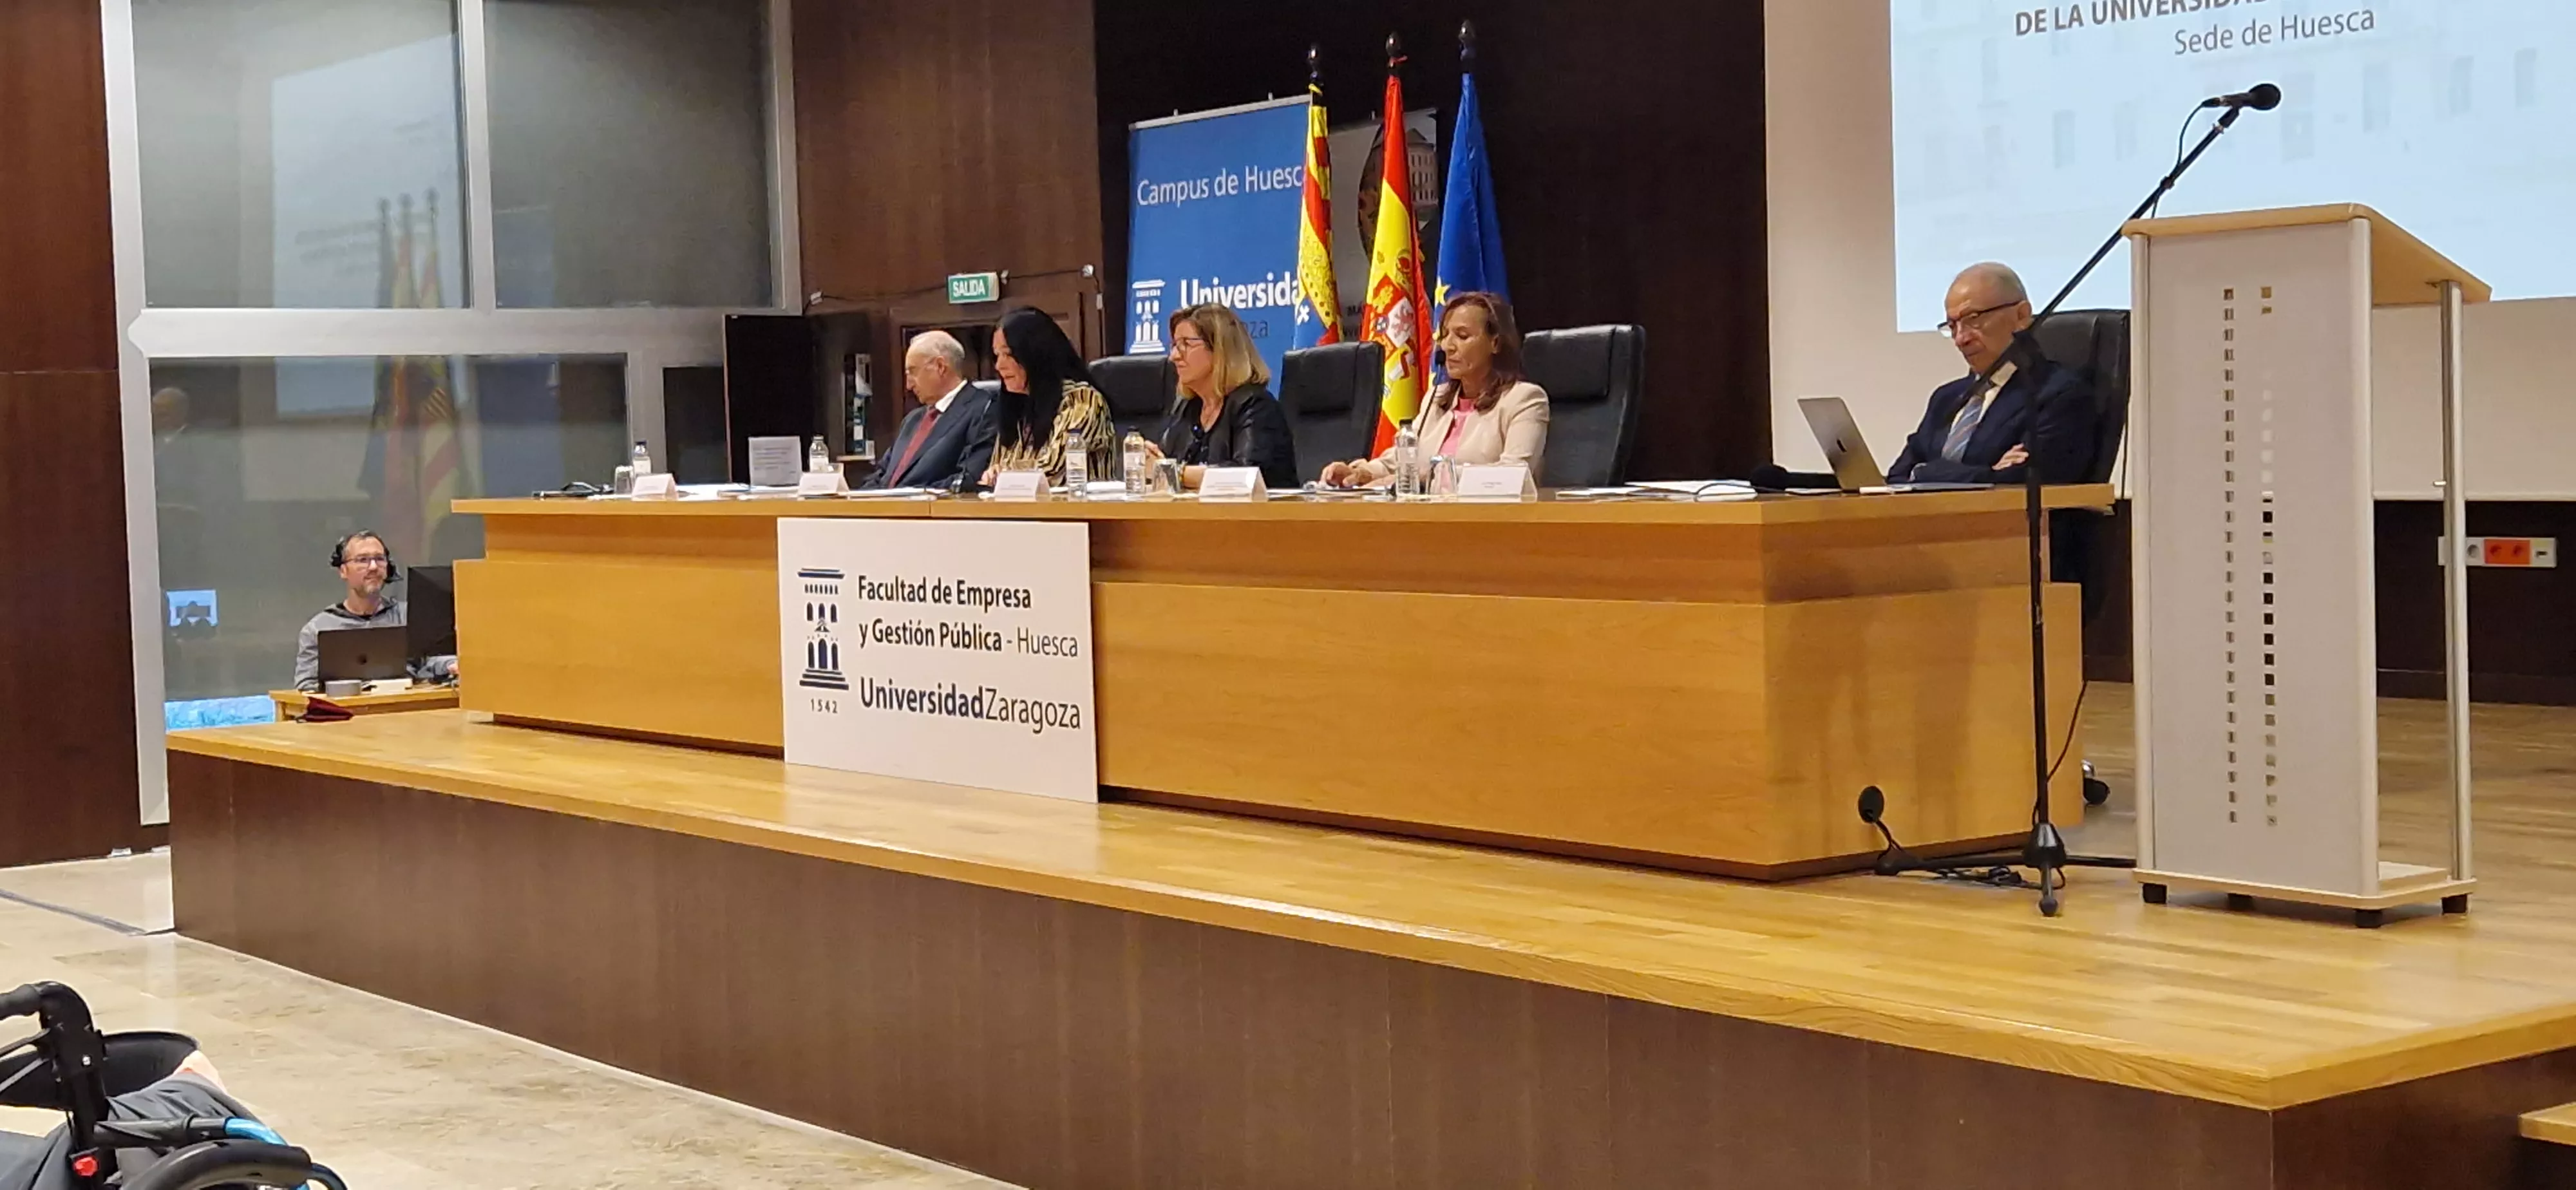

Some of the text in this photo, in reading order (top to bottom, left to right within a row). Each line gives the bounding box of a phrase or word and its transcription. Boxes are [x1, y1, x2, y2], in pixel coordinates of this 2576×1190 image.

[2016, 0, 2268, 36] DE LA UNIVER
[2174, 9, 2375, 55] Sede de Huesca
[1137, 164, 1302, 208] Campus de Huesc
[952, 279, 986, 298] SALIDA
[1180, 271, 1298, 309] Universida
[858, 575, 1032, 613] Facultad de Empresa
[858, 623, 868, 649] y
[872, 618, 935, 647] Gestión
[939, 621, 1002, 652] Pública
[1017, 626, 1079, 657] Huesca
[811, 698, 838, 713] 1542
